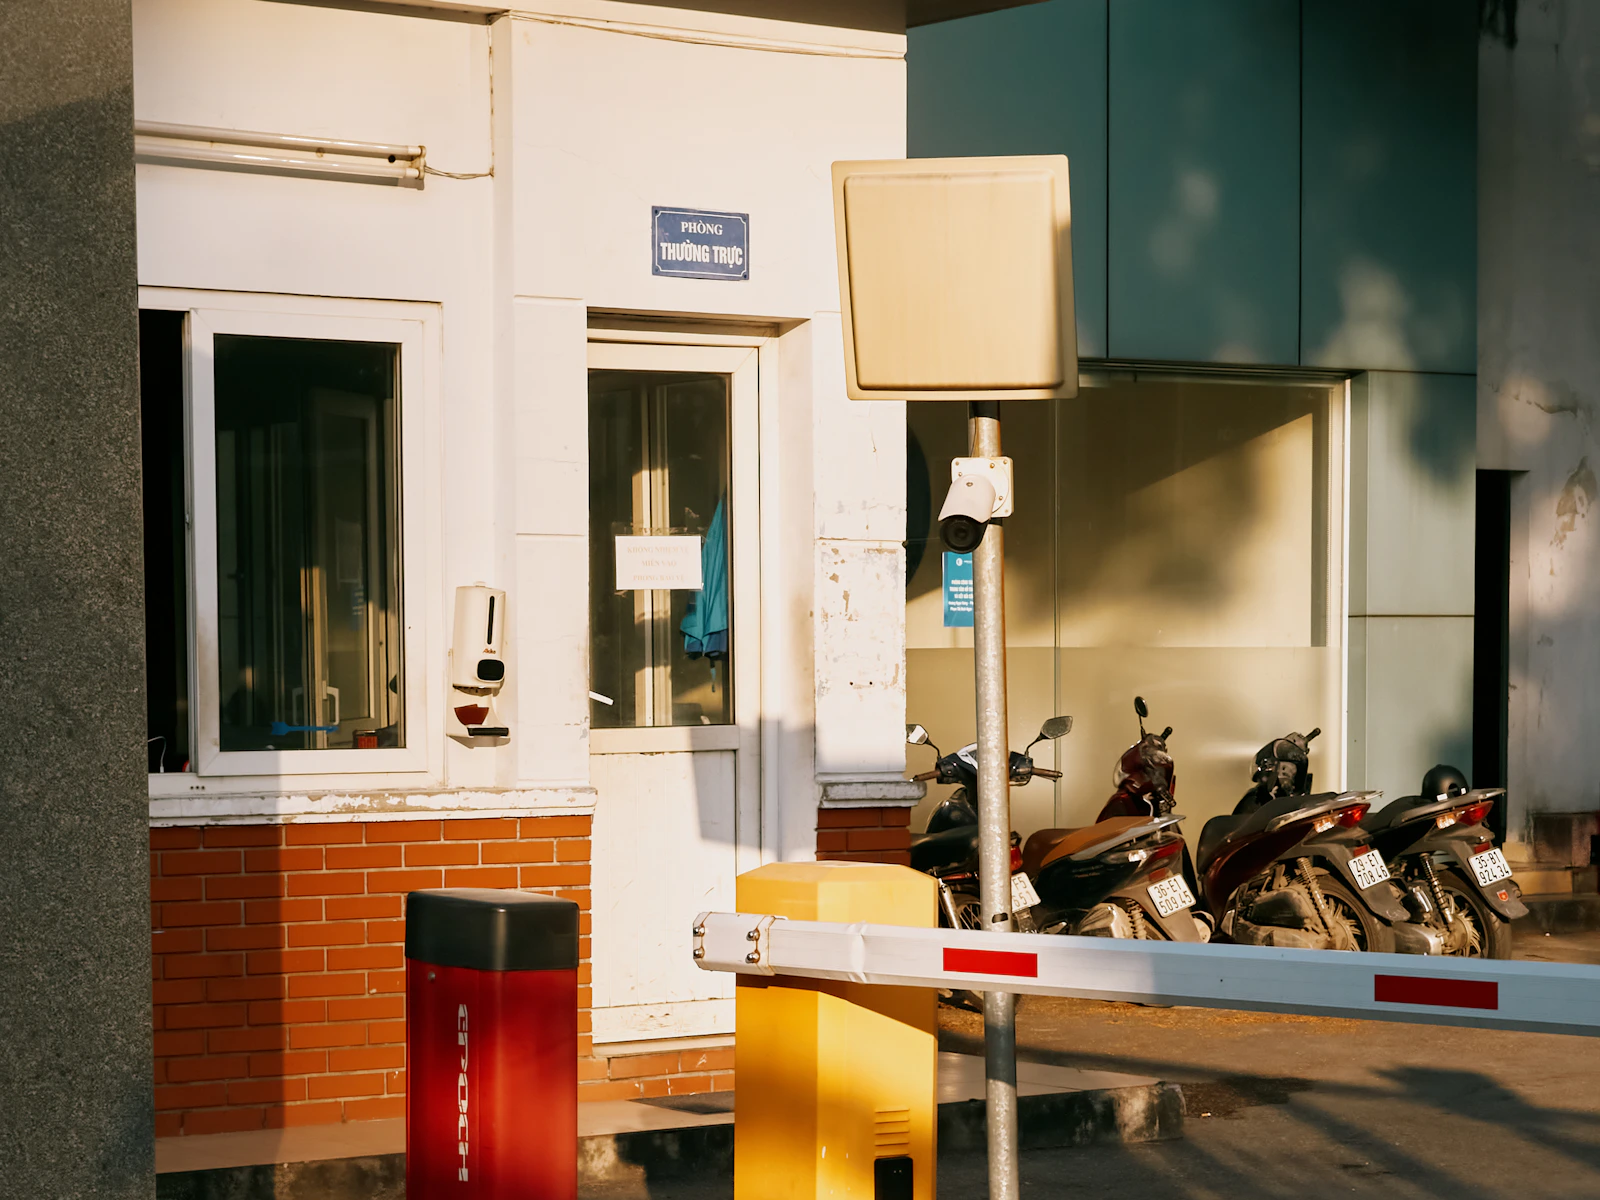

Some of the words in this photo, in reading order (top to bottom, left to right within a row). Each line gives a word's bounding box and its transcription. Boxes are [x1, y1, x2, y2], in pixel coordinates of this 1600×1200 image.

[681, 219, 723, 236] PHÒNG
[660, 239, 710, 263] THƯỜNG
[712, 245, 743, 269] TRỰC
[1153, 878, 1182, 899] 36-E1
[1158, 890, 1193, 914] 509.45
